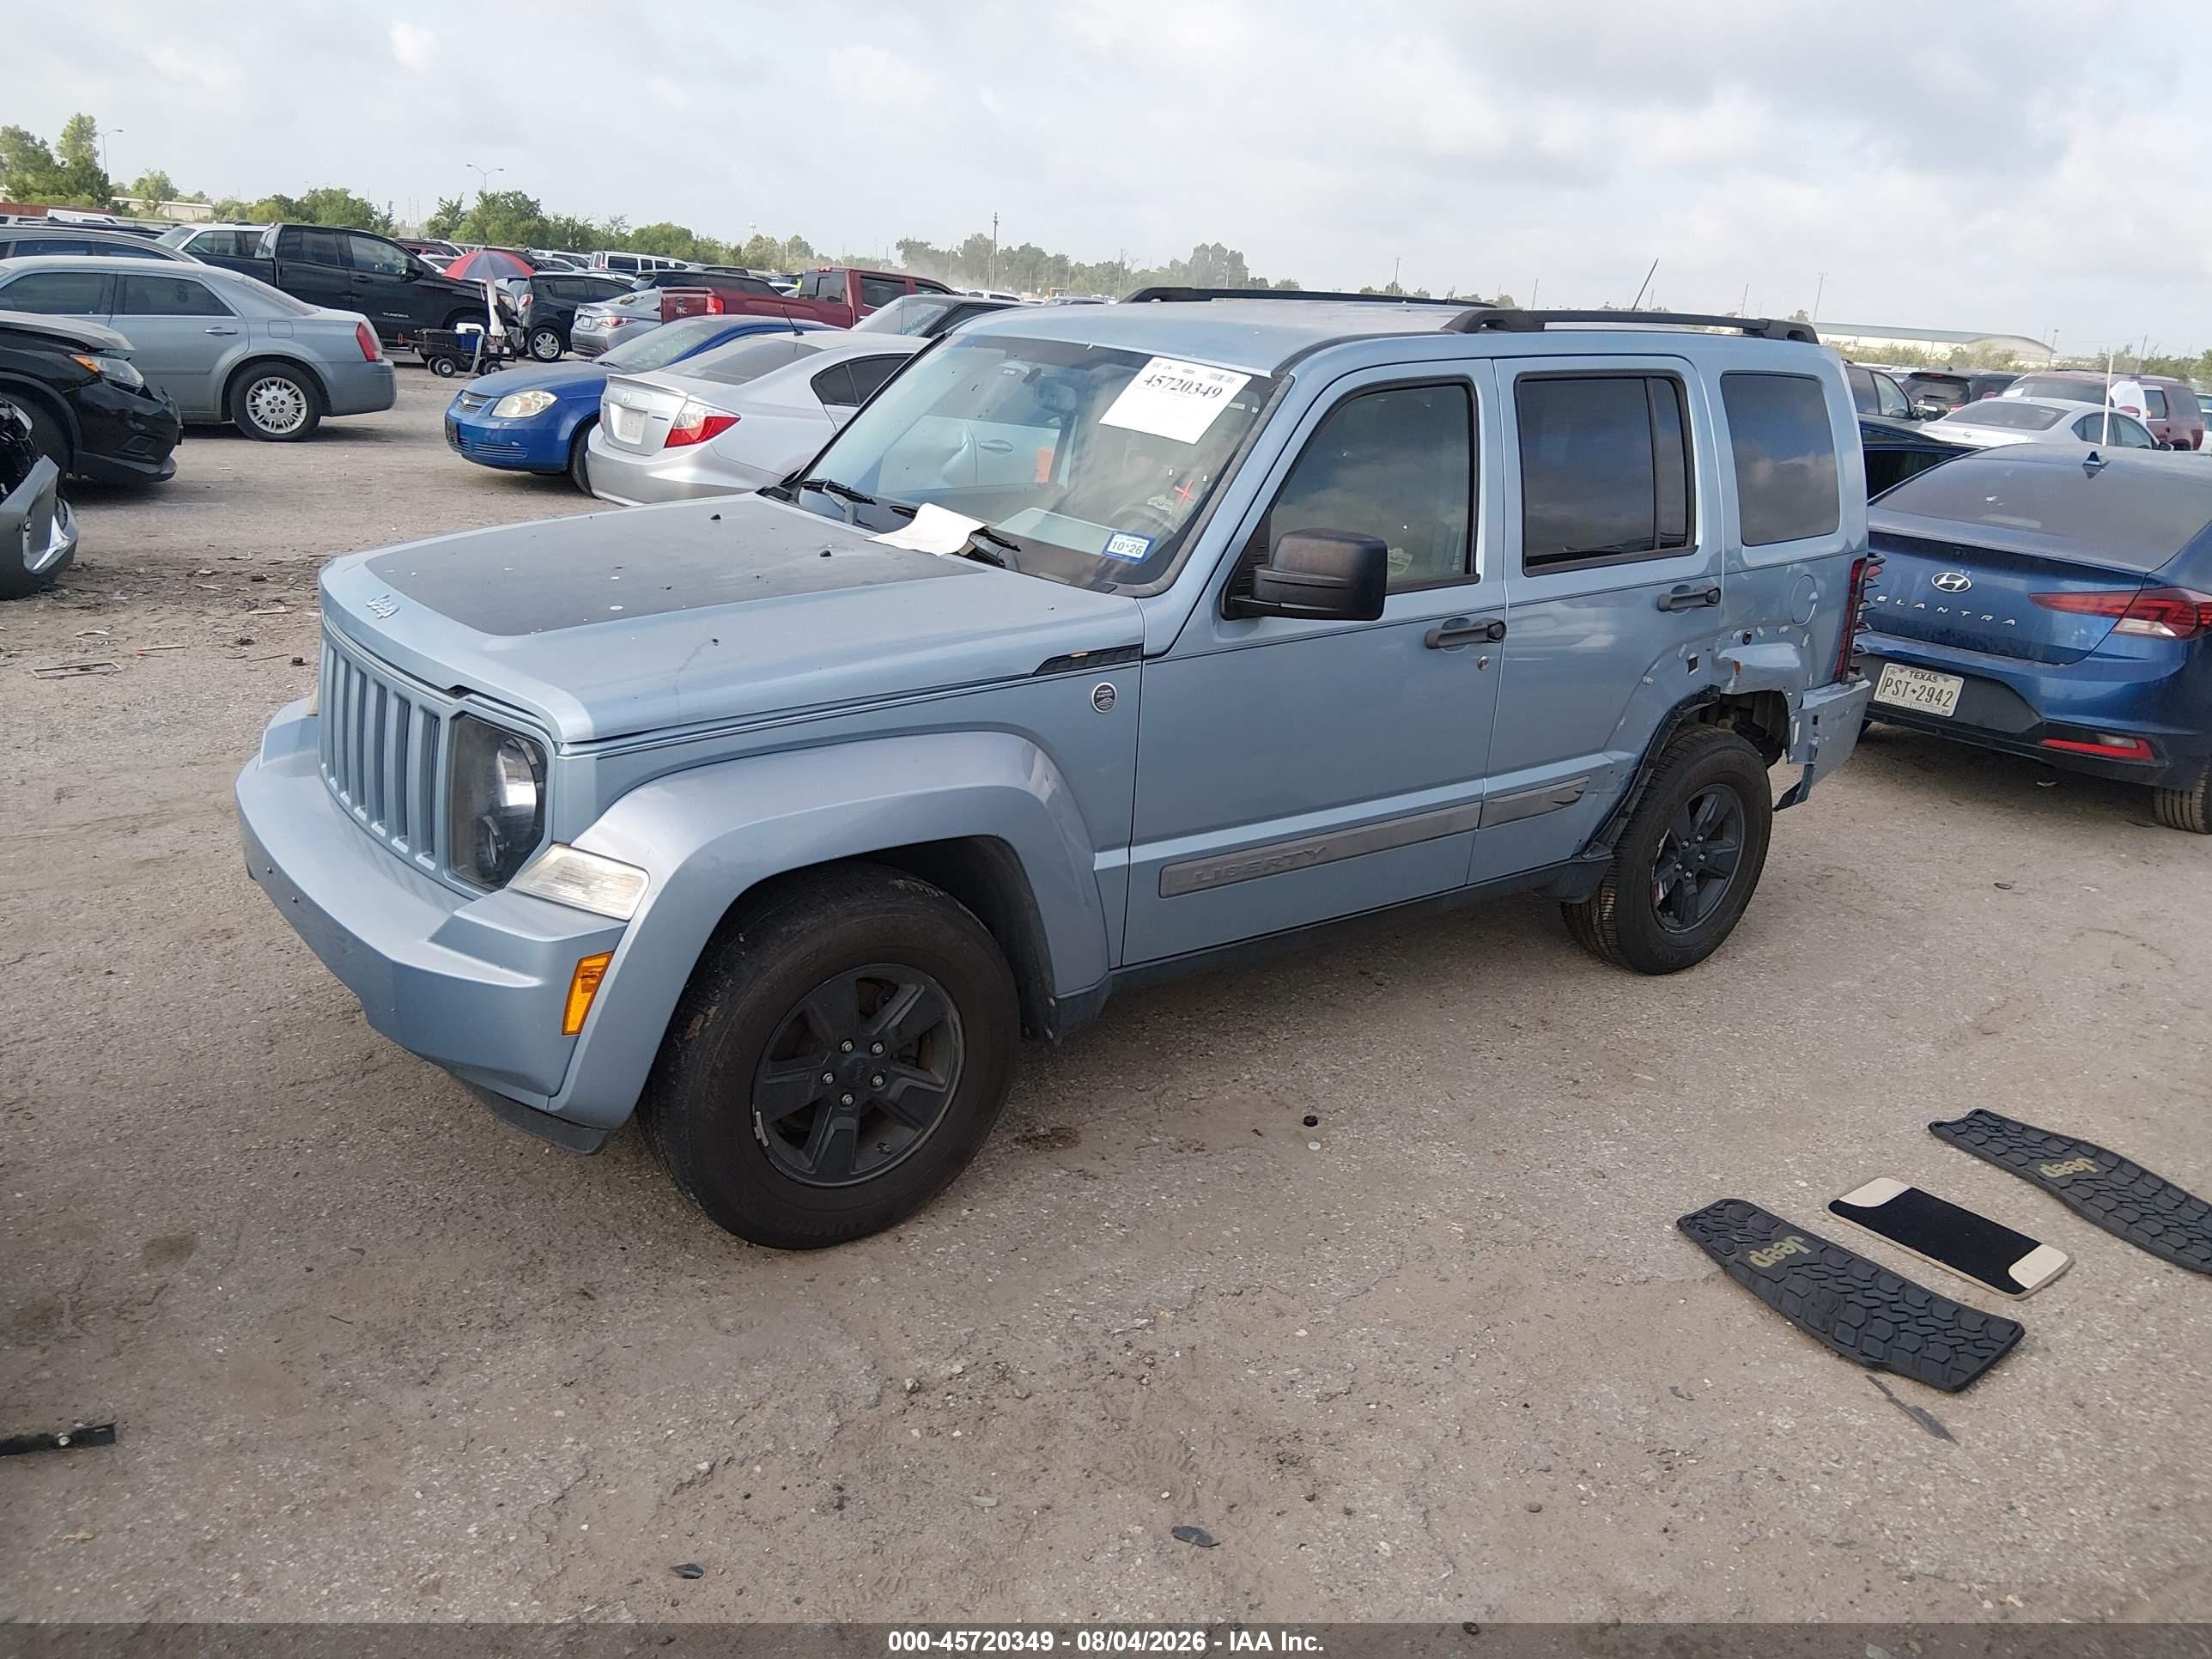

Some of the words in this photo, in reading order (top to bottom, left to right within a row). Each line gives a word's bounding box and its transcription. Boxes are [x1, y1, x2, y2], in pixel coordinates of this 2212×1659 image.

[1144, 374, 1223, 398] 45720349
[365, 594, 400, 619] Jeep
[1876, 595, 2016, 626] ELANTRA
[1910, 671, 1937, 683] TEXAS
[1195, 845, 1327, 884] LIBERTY
[2039, 1158, 2100, 1178] Jeep
[1749, 1235, 1812, 1267] Jeep
